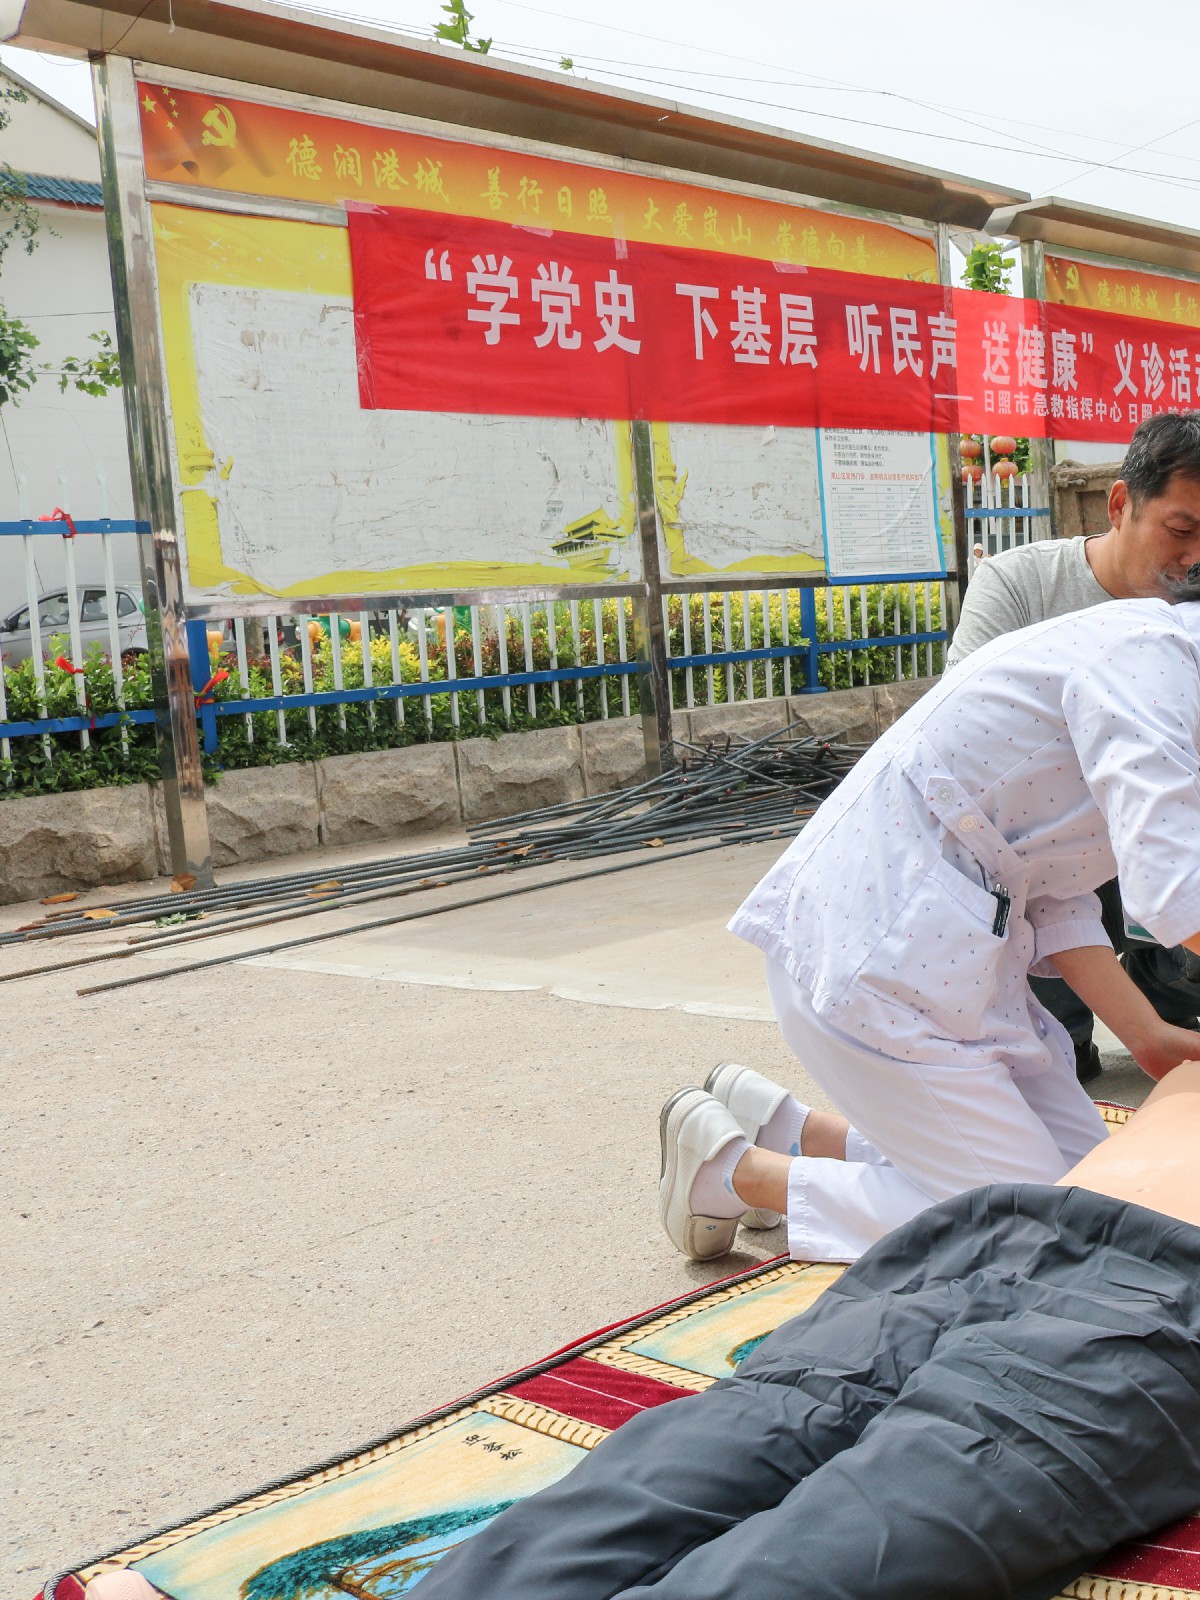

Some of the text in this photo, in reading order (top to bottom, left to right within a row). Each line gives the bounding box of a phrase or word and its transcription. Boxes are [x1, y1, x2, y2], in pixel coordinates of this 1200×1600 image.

[286, 134, 871, 269] 德润港城 善行日照 大爱岚山 崇德向善
[425, 248, 641, 355] “学党史
[675, 282, 818, 370] 下基层
[846, 304, 957, 381] 听民声
[982, 320, 1093, 391] 送健康”
[1096, 279, 1160, 317] 德润港城
